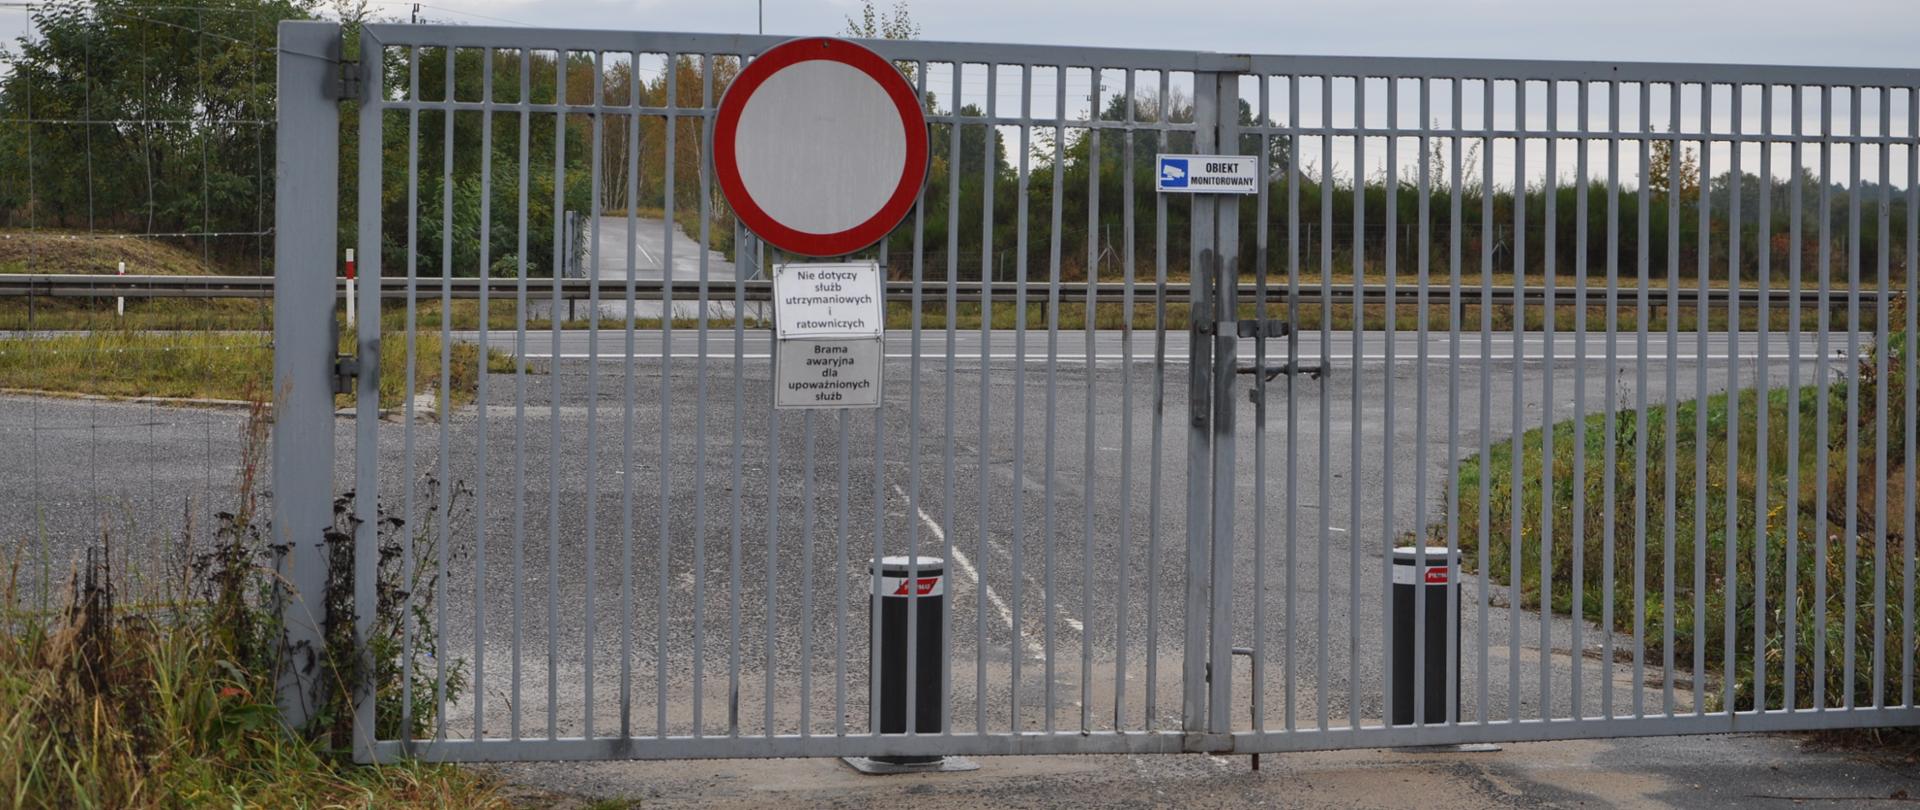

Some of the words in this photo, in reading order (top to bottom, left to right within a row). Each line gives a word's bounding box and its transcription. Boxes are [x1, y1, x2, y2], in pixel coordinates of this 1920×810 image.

[1206, 163, 1239, 173] OBIEKT
[1191, 177, 1254, 186] MONITOROWANY
[797, 271, 815, 280] Nie
[818, 271, 858, 284] dotyczy
[814, 282, 842, 292] służb
[785, 294, 872, 306] utrzymaniowych
[796, 318, 865, 330] ratowniczych
[814, 345, 848, 354] Brama
[806, 356, 855, 368] awaryjna
[822, 368, 838, 377] dla
[788, 379, 870, 391] upoważnionych
[815, 391, 842, 401] służb
